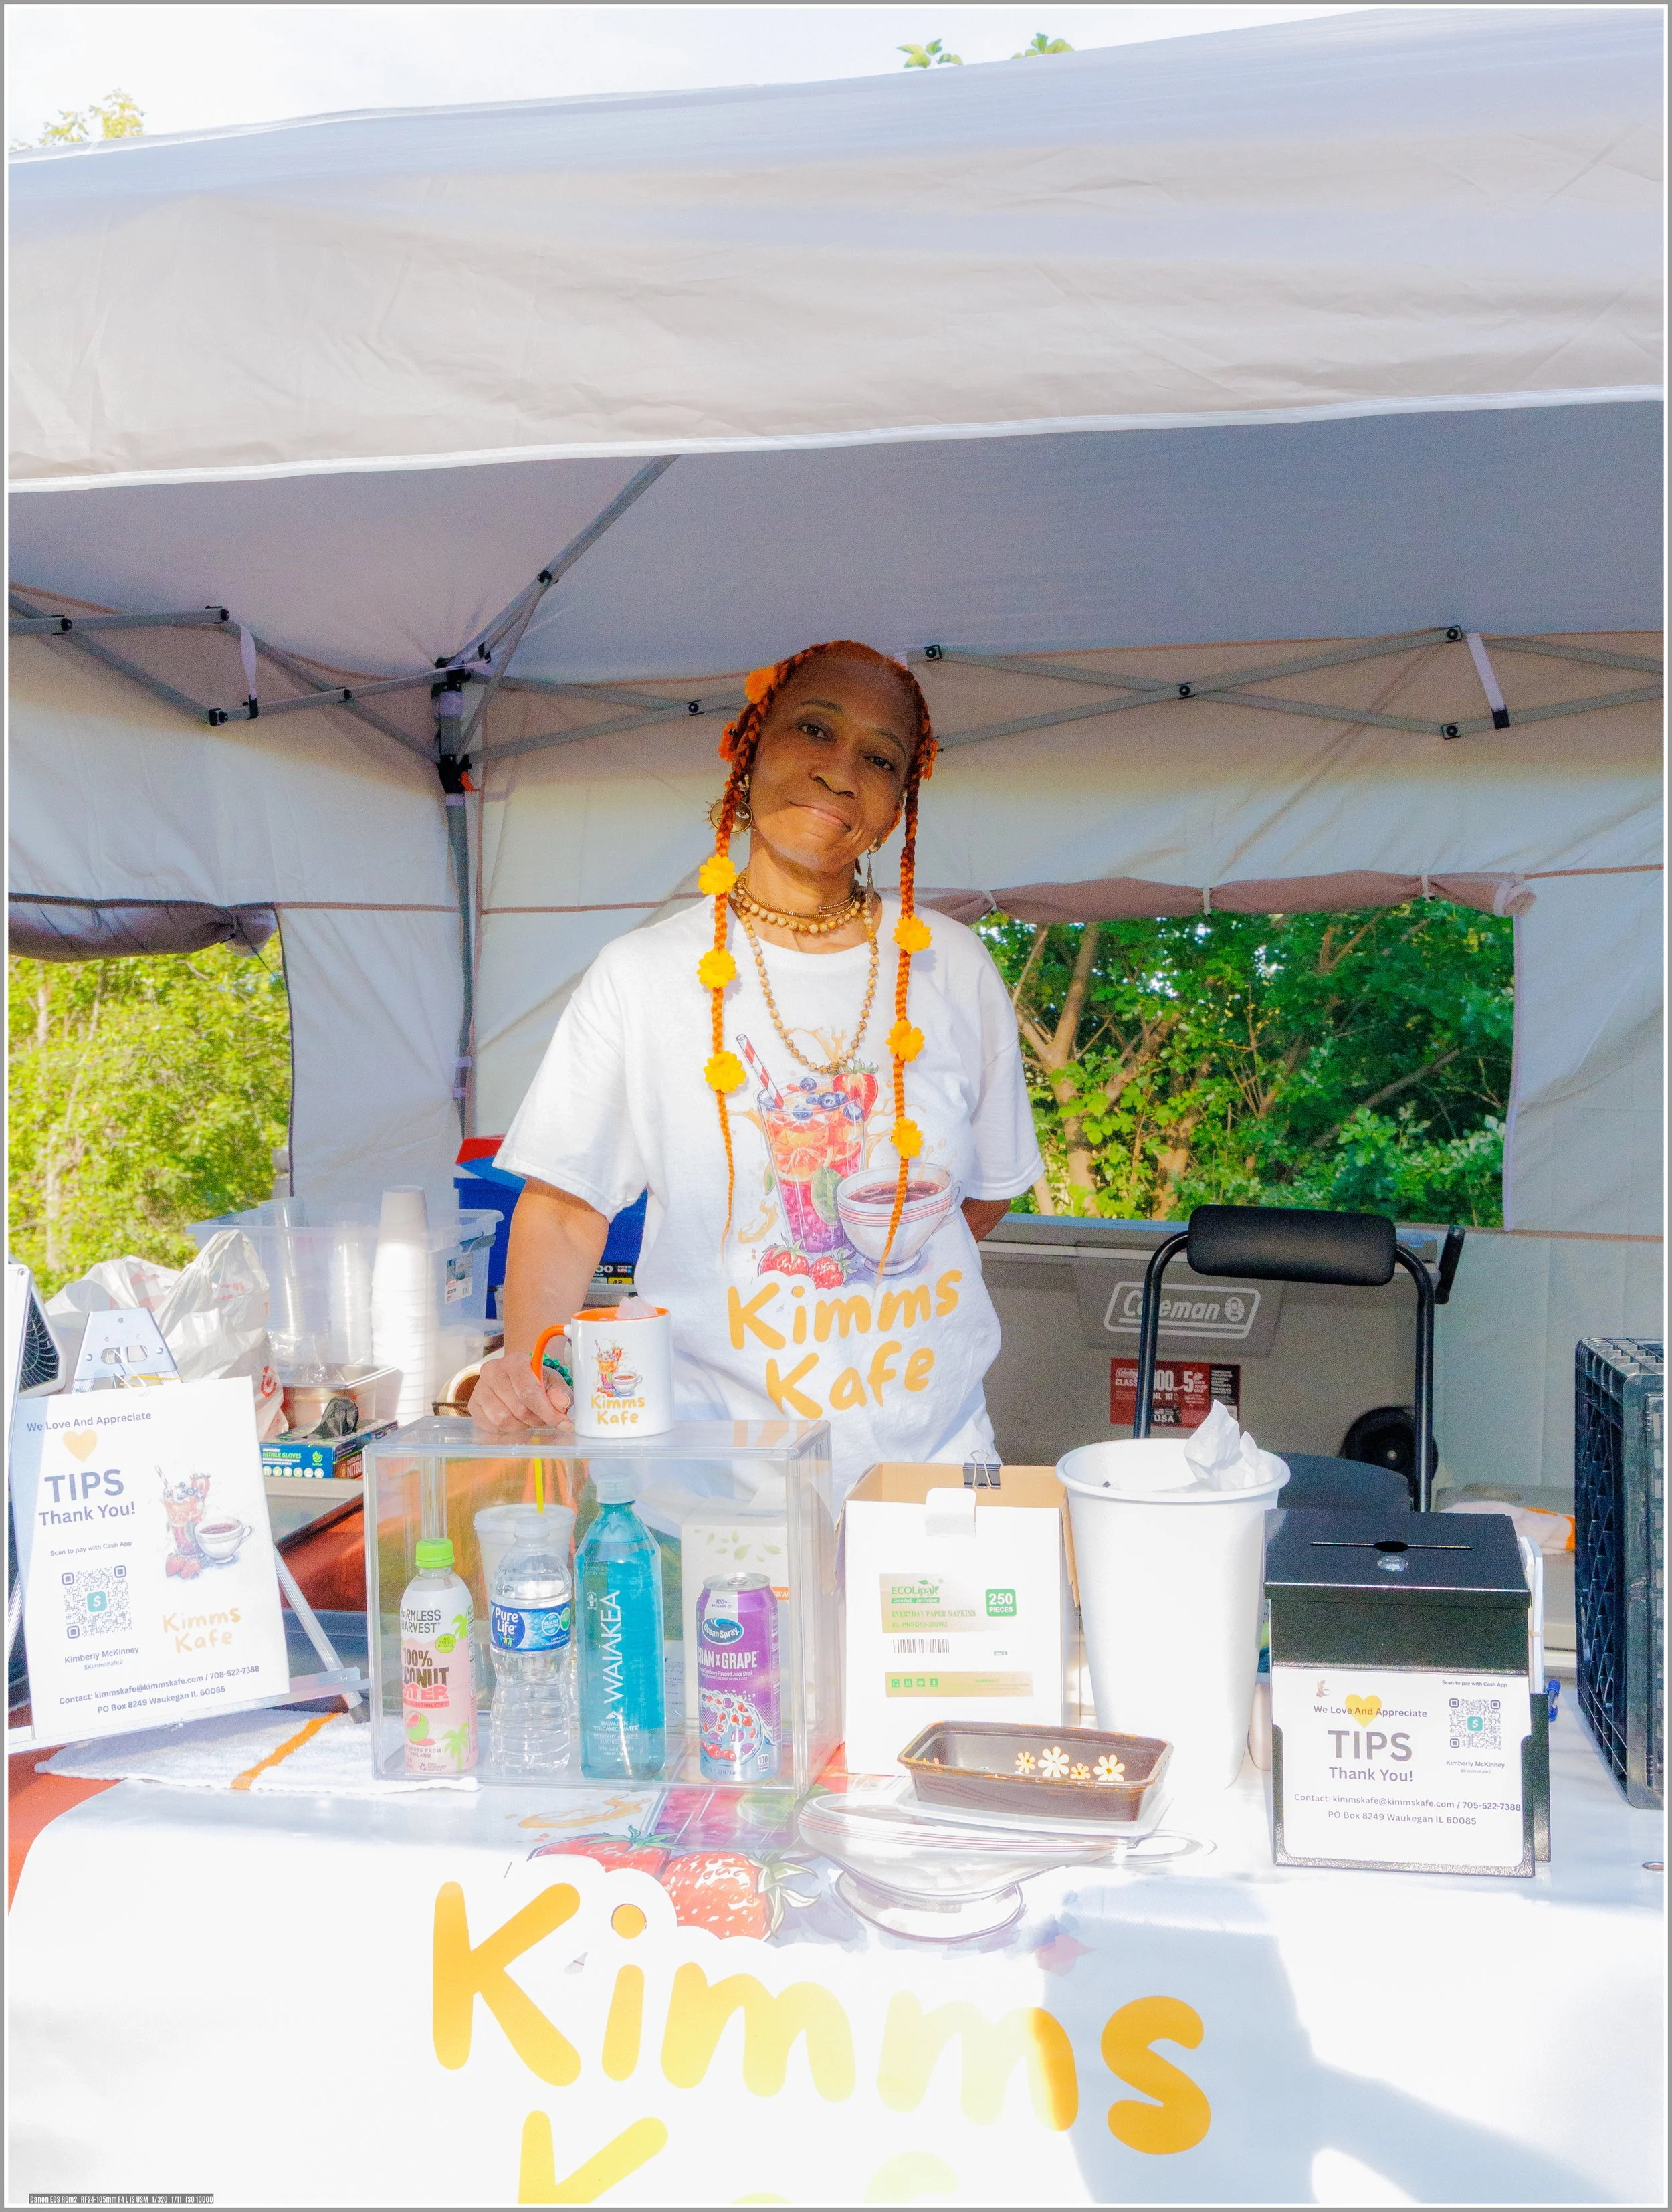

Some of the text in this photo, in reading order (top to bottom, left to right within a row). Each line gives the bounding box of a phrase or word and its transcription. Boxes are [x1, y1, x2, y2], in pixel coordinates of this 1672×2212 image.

[728, 1269, 963, 1350] Kimms
[1124, 1290, 1221, 1320] Ceman
[766, 1340, 935, 1419] Kafe
[591, 1394, 645, 1409] Kimms
[27, 1412, 152, 1432] We Love And Appreciate
[597, 1410, 639, 1425] Kafe
[1154, 1415, 1174, 1423] USA
[44, 1468, 124, 1503] TIPS
[39, 1501, 136, 1526] Thank You!
[988, 1593, 1013, 1605] 250
[162, 1607, 241, 1634] Kimms
[401, 1607, 441, 1621] ARMLESS
[495, 1607, 519, 1623] Pure
[947, 1609, 976, 1617] NAPKINS
[497, 1619, 517, 1637] Life
[175, 1629, 233, 1654] Kafe
[64, 1647, 139, 1664] Kimberly McKinney
[722, 1651, 758, 1670] GRAPE
[59, 1665, 260, 1705] Contact: kimmskafe@kimmskafe.com / 708-522-7388
[97, 1686, 226, 1714] PO Box 8249 Waukegan IL 60085
[1313, 1705, 1428, 1718] We Love And Appreciate
[1327, 1730, 1413, 1762] TIPS
[758, 1755, 768, 1765] 100
[1475, 1761, 1505, 1769] McKinney
[1328, 1766, 1414, 1783] Thank You!
[1294, 1793, 1521, 1812] Contact: kimmskafe@kimmskafe.com / 705-522-7388
[1328, 1811, 1477, 1826] PO Box 8249 Waukegan IL 60085
[431, 1880, 1212, 2156] Kimms
